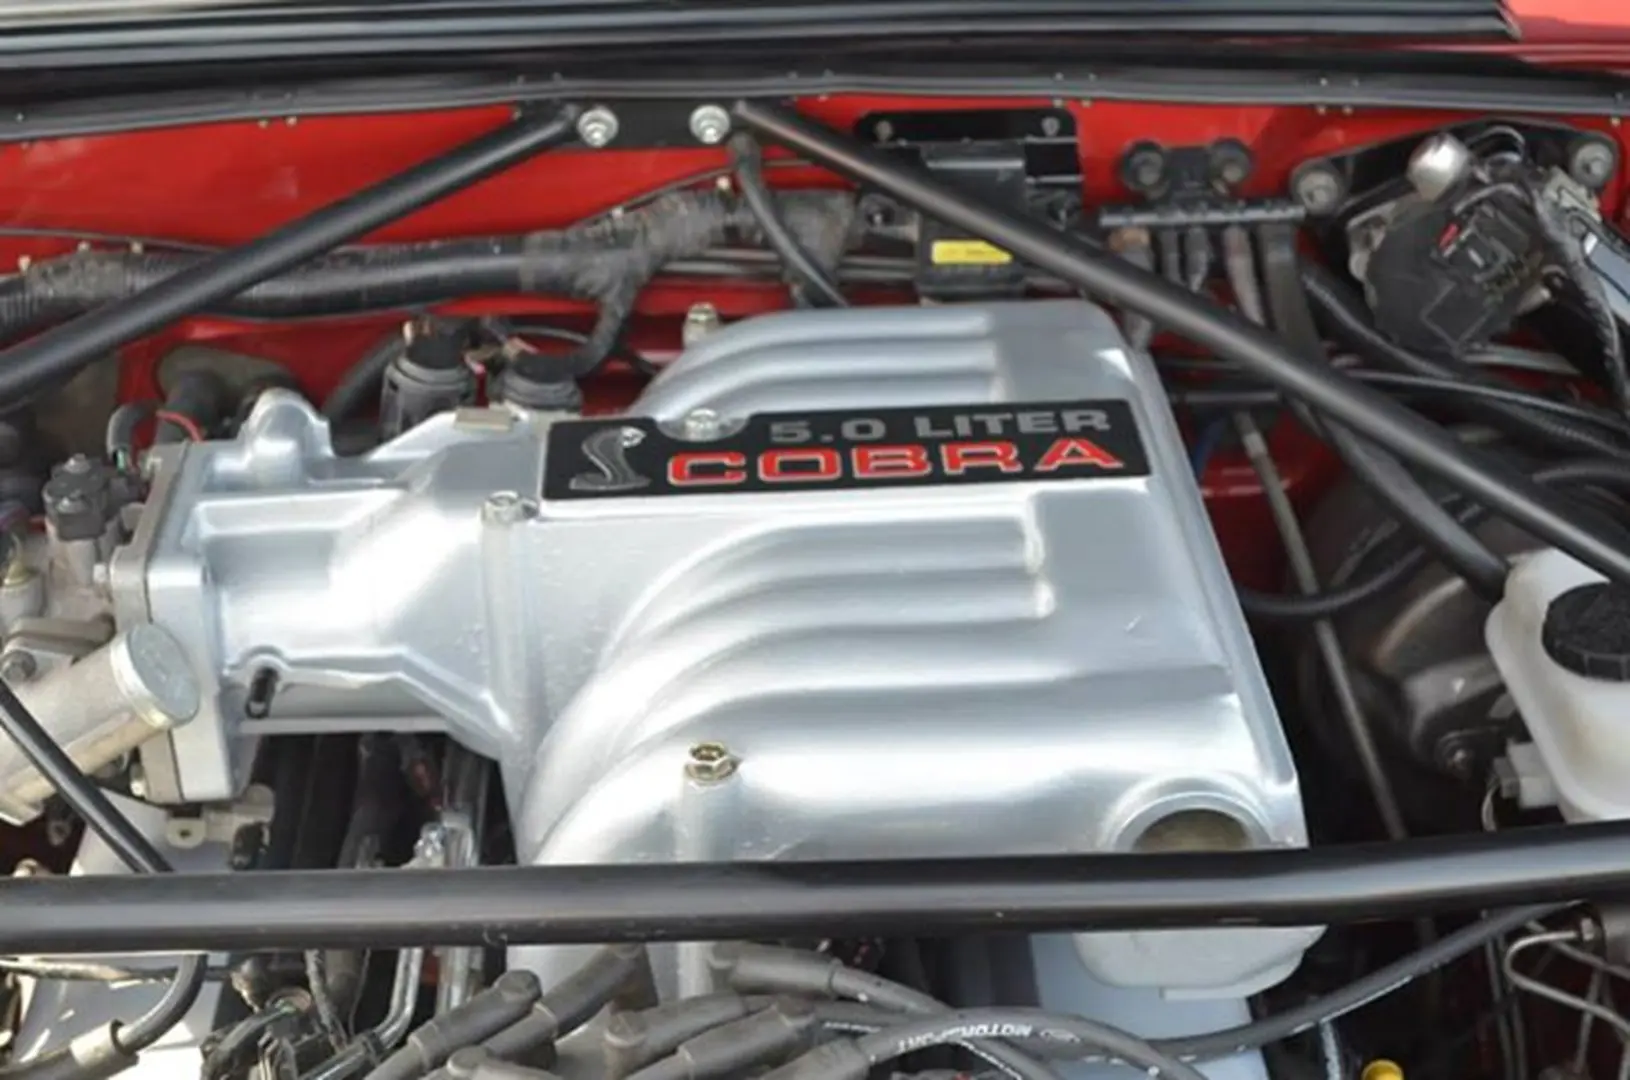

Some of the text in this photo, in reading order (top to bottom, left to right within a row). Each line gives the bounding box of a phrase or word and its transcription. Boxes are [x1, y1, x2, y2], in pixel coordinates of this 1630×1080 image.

[769, 409, 1111, 443] 5.0 LITER
[667, 436, 1126, 486] COBRA
